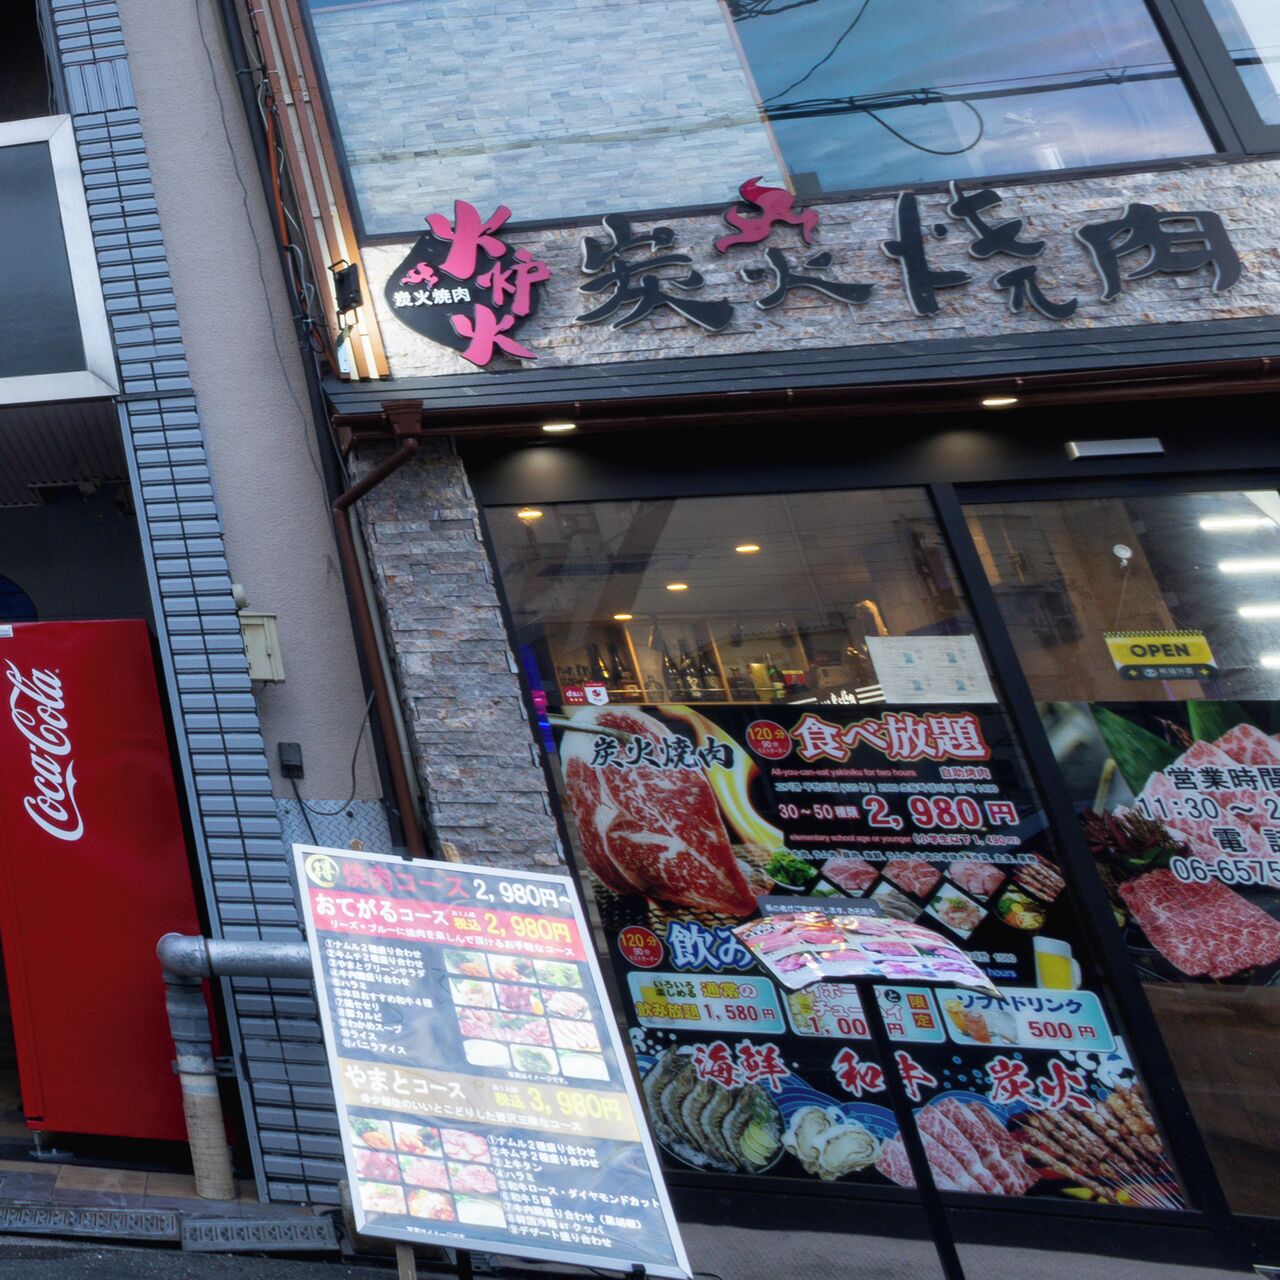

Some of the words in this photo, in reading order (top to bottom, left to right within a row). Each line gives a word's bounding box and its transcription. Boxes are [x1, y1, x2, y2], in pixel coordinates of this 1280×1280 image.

[1131, 643, 1191, 658] OPEN
[4, 658, 84, 841] Coca-Cola
[748, 727, 786, 740] 120分
[795, 714, 988, 760] 食べ放題
[591, 736, 734, 769] 炭火焼肉
[1167, 768, 1280, 791] 営業時間
[864, 796, 1019, 830] 2,980円
[1139, 798, 1219, 819] 11:30
[343, 862, 470, 899] 焼肉コース
[315, 893, 449, 926] おてがるコース
[484, 912, 571, 944] 2,980円
[621, 933, 657, 947] 120分
[654, 980, 694, 989] いろいろ
[655, 988, 696, 998] 楽しめる
[700, 981, 758, 999] 通常の
[635, 1002, 700, 1020] 飲み放題
[704, 1003, 776, 1021] 1,580円
[908, 995, 935, 1028] 限定
[1028, 1021, 1097, 1039] 500円
[693, 1042, 789, 1090] 海鮮
[345, 1065, 466, 1100] やまとコース
[987, 1056, 1095, 1111] 炭火
[527, 1086, 623, 1122] 3,980円
